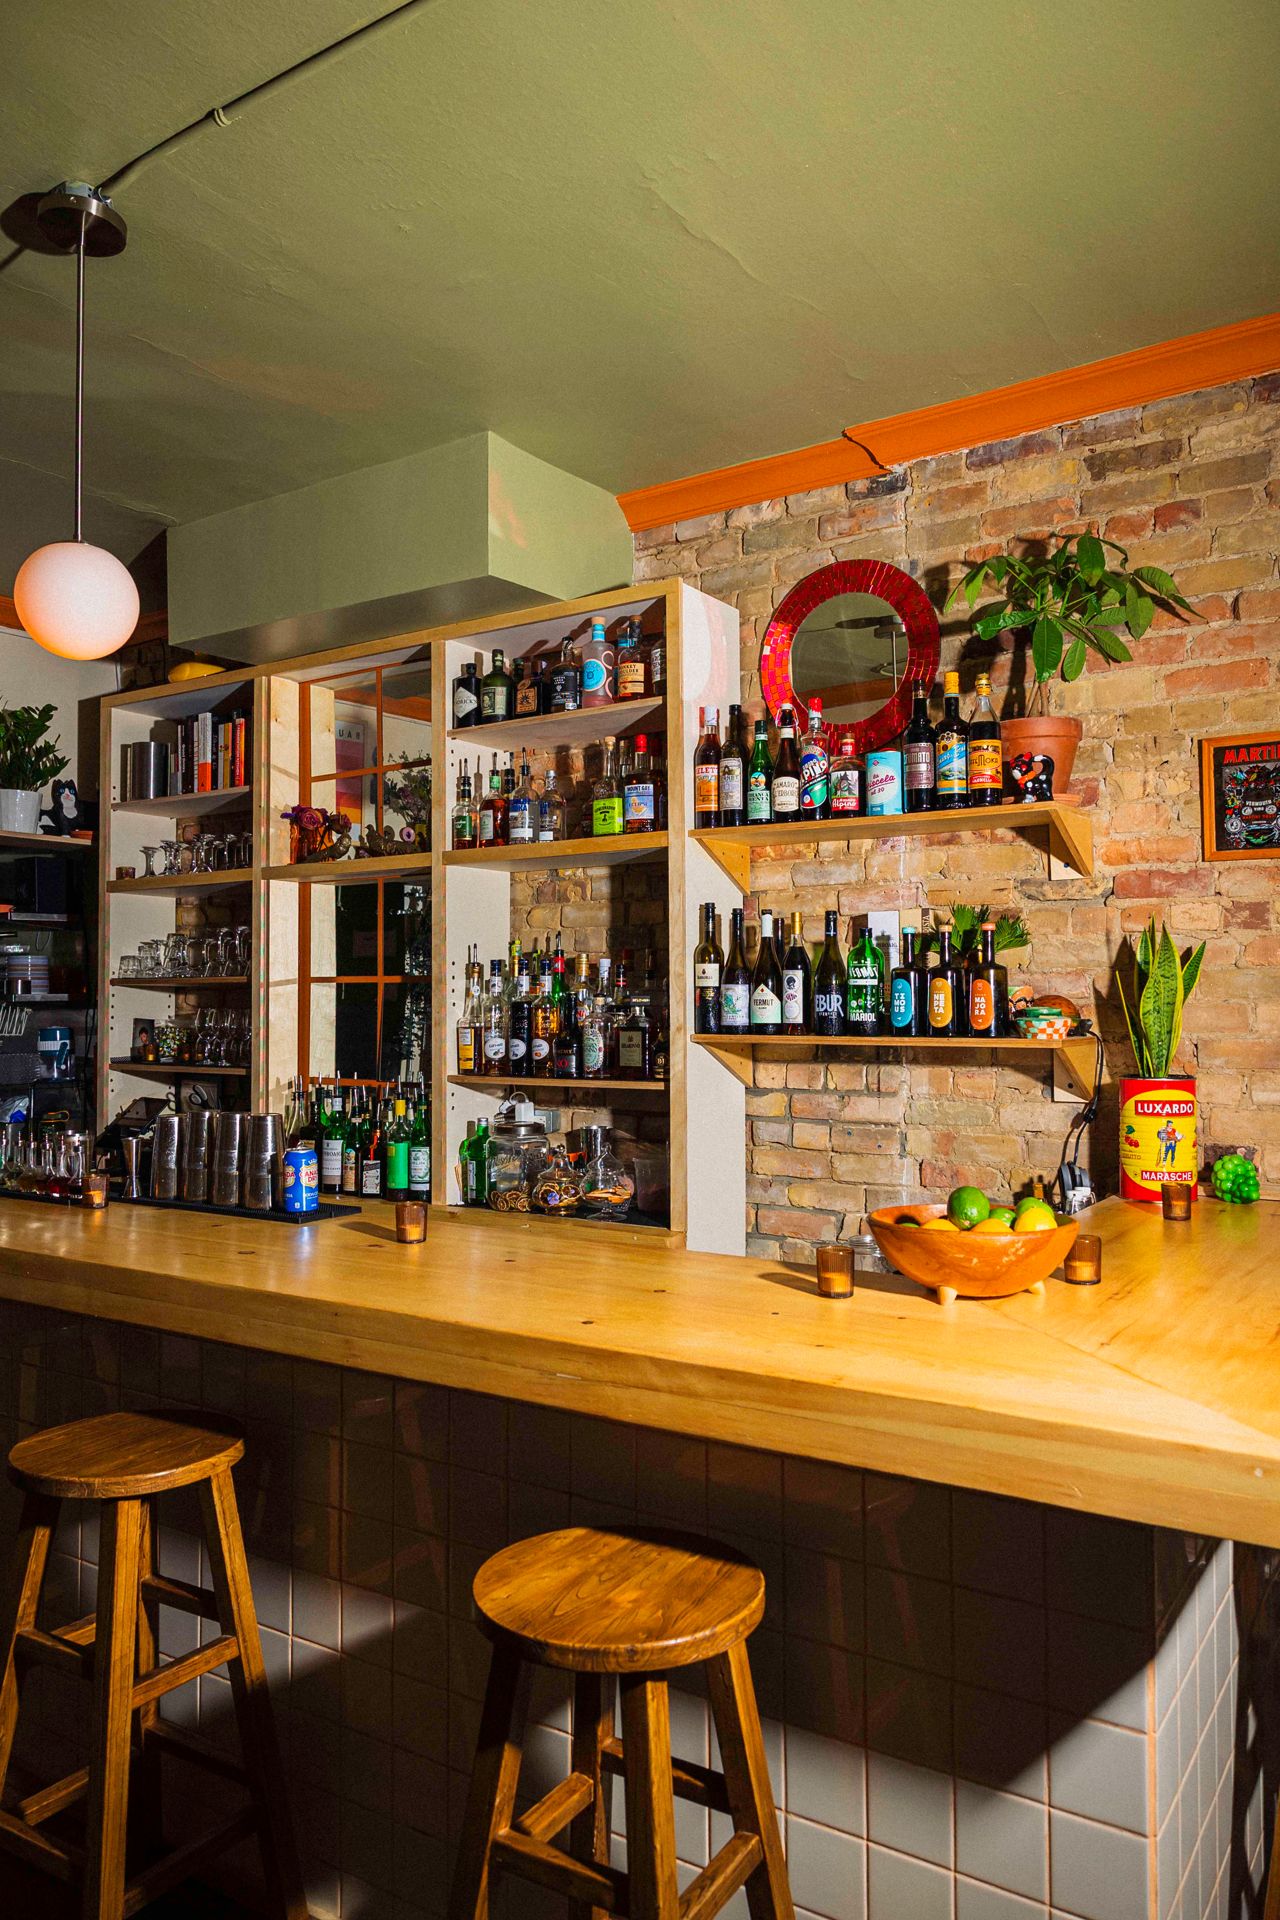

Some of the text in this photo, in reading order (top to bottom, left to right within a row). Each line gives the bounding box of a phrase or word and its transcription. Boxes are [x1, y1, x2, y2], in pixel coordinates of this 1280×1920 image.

[1223, 743, 1280, 765] MARTI
[1138, 1103, 1193, 1114] LUXARDO
[1142, 1172, 1192, 1181] MARASCHE
